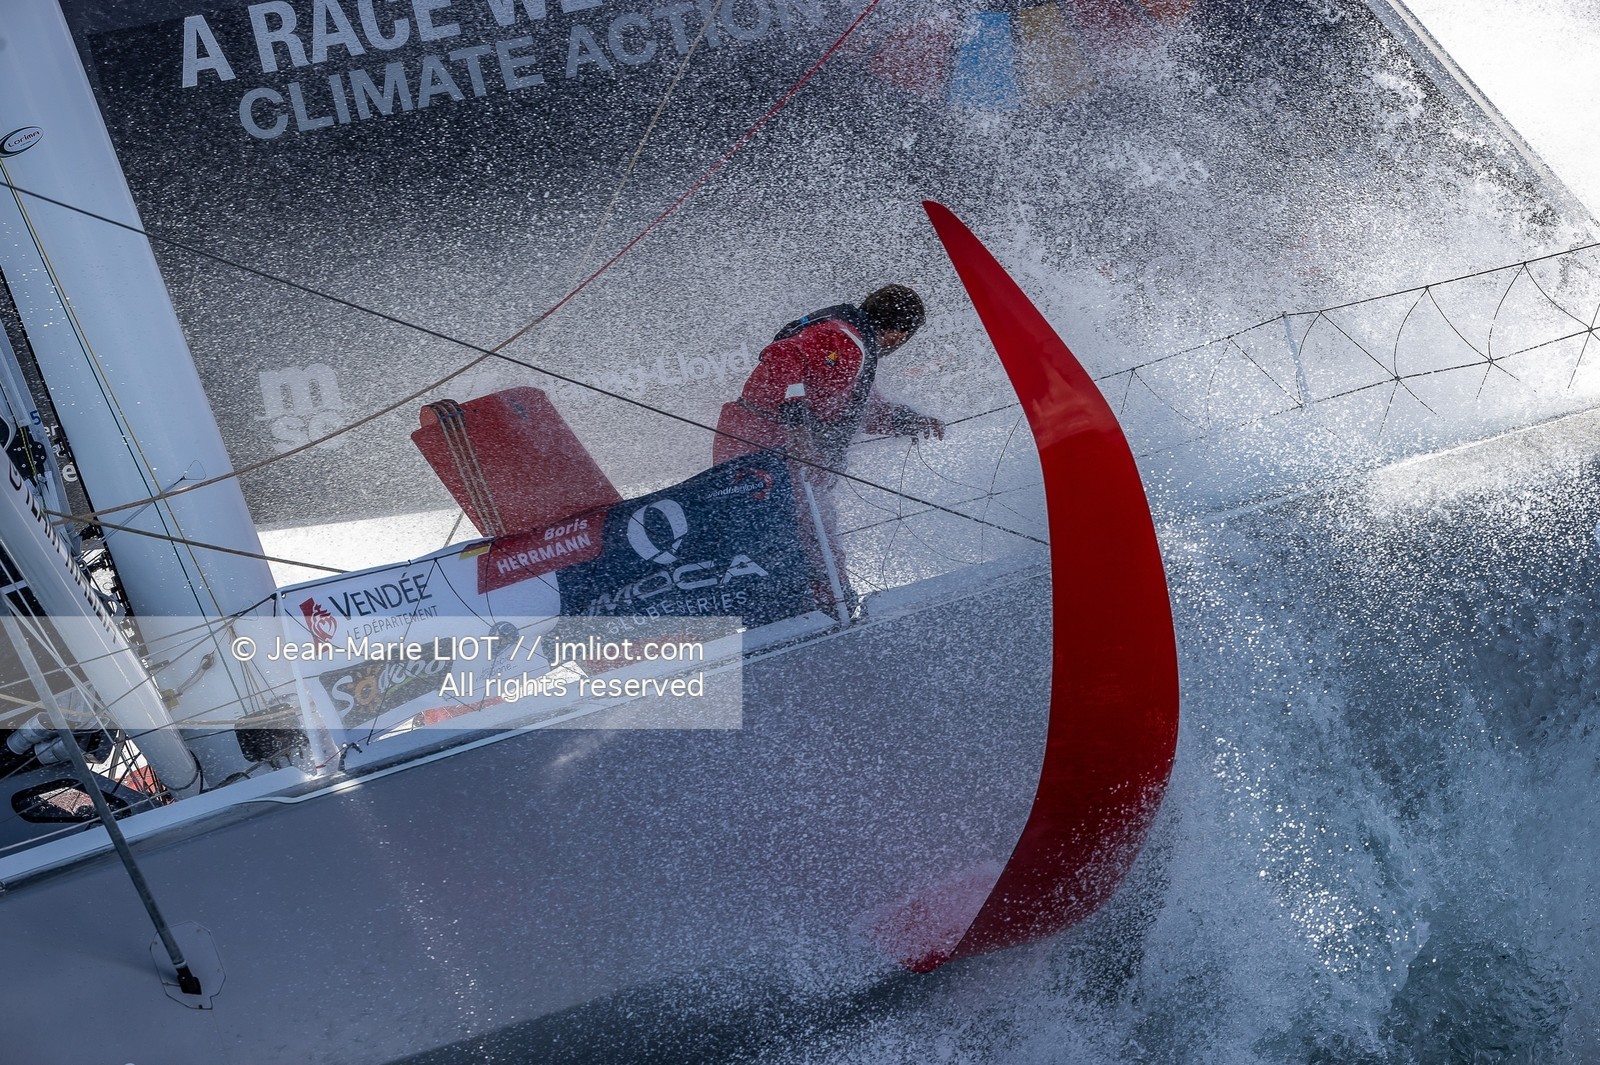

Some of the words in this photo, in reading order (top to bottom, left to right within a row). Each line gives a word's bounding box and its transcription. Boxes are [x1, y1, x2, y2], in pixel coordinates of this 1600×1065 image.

[182, 14, 237, 89] A
[248, 0, 462, 74] RACE
[238, 36, 546, 140] CLIMATE
[564, 0, 820, 79] ACTIO
[544, 518, 588, 541] Boris
[496, 532, 592, 576] HERRMANN
[328, 572, 433, 621] VENDÉE
[346, 626, 362, 641] LE
[364, 605, 438, 637] DÉPARTEMENT
